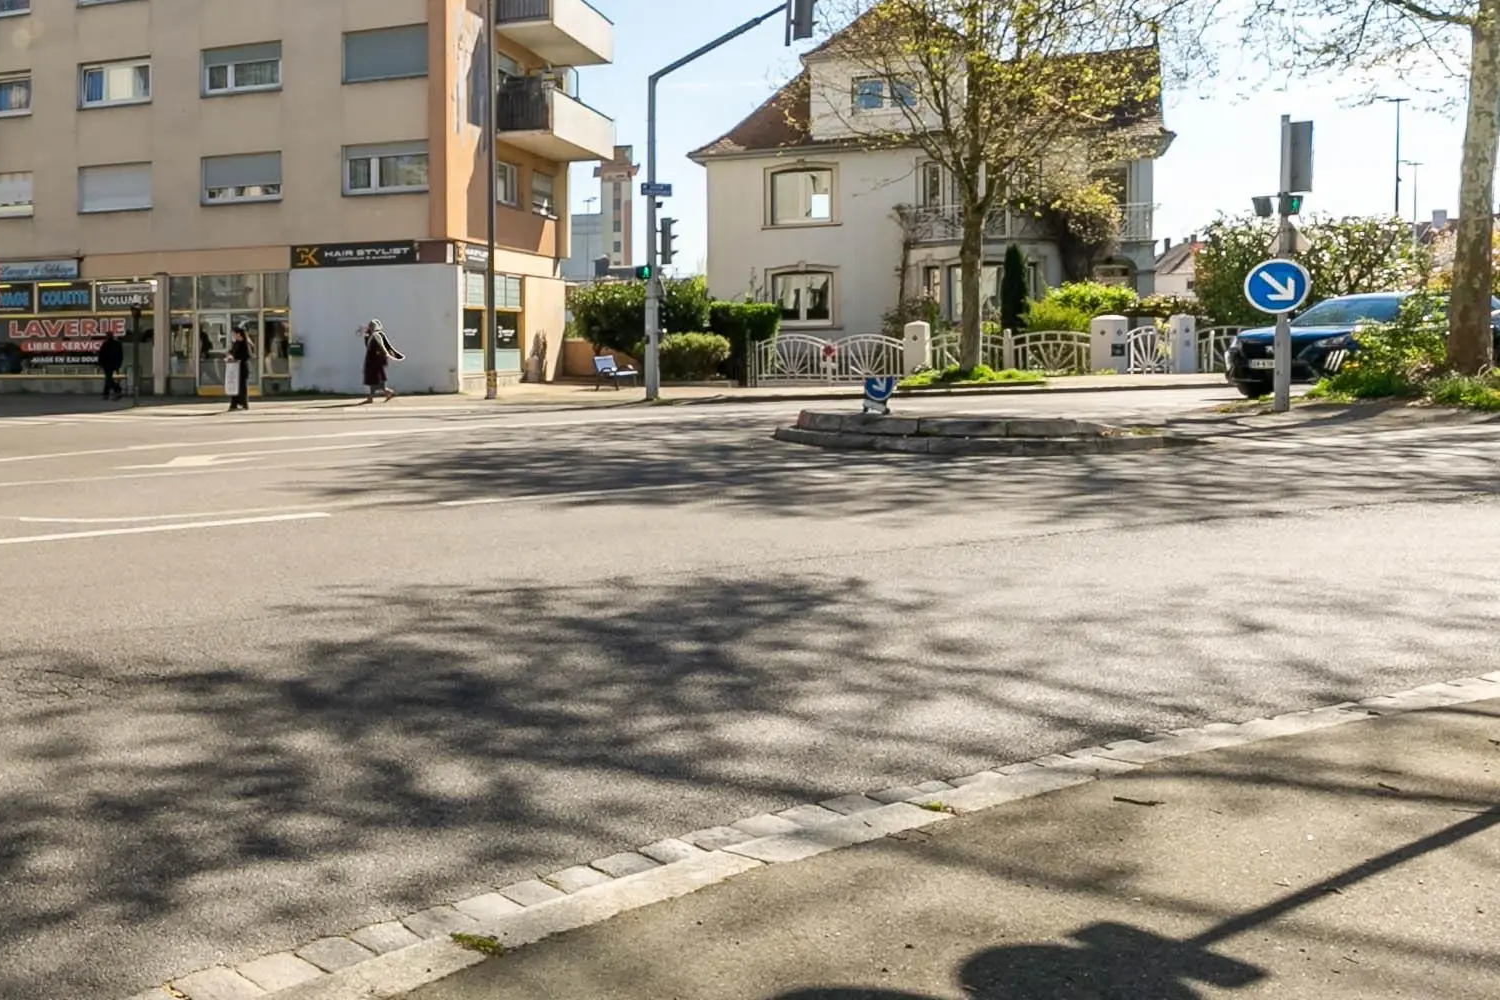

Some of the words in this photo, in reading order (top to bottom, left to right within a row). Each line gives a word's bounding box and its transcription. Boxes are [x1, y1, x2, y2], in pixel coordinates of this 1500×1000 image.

[324, 250, 354, 258] HAIR
[356, 247, 410, 256] STYLIST
[41, 290, 88, 305] COUETTE
[9, 318, 126, 338] LAVERIE
[28, 341, 56, 351] LIBRE
[61, 340, 101, 351] SERVIC
